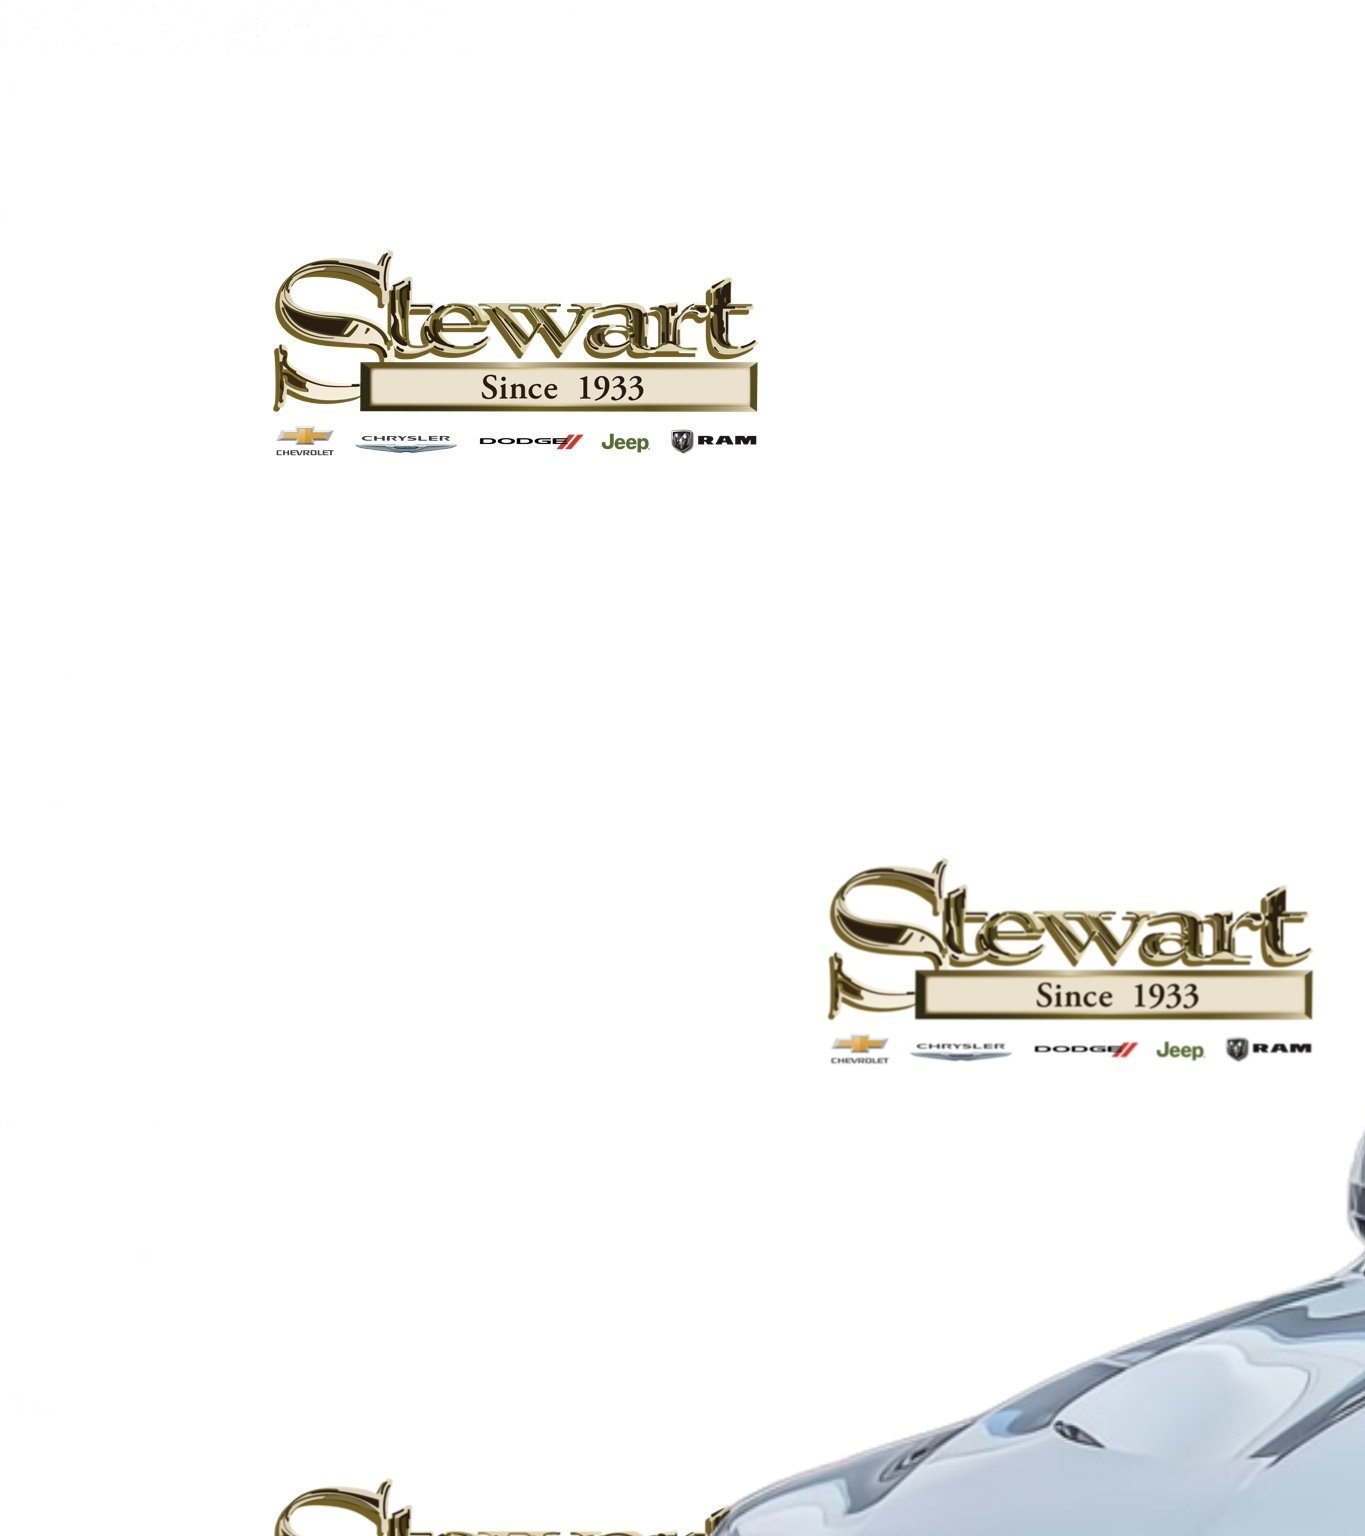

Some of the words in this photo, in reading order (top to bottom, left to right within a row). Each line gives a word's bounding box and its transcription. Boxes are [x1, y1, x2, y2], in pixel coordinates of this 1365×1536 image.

[273, 250, 757, 411] Stewart
[481, 374, 558, 400] Since
[579, 375, 645, 402] 1933
[601, 433, 650, 452] Jeep
[698, 435, 757, 445] RAM
[827, 859, 1311, 1020] Stewart
[1035, 983, 1112, 1009] Since
[1133, 984, 1199, 1011] 1933
[1155, 1042, 1204, 1061] Jeep
[1252, 1044, 1311, 1054] RAM
